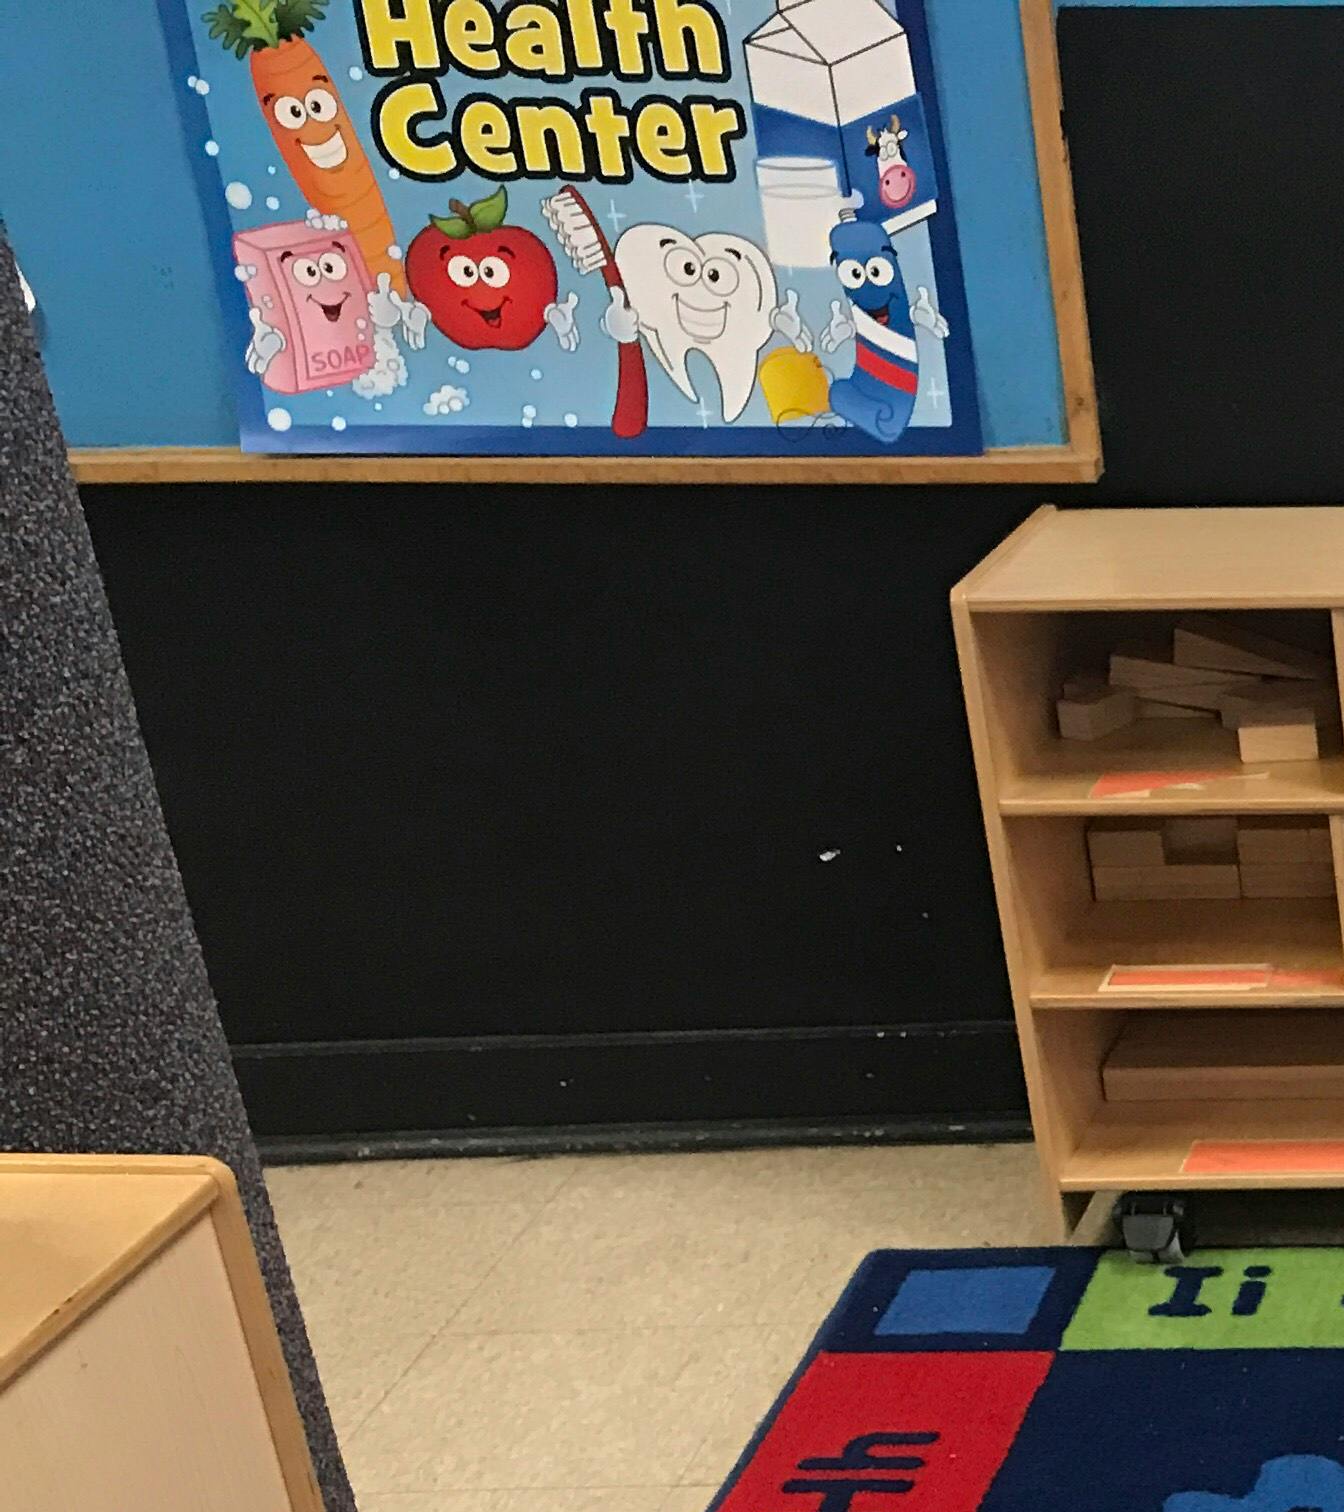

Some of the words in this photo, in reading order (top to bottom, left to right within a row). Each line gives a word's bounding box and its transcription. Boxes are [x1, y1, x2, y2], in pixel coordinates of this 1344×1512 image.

[362, 0, 728, 80] Health
[375, 80, 743, 180] Center
[310, 344, 370, 372] SOAP
[1148, 1265, 1273, 1318] Ii
